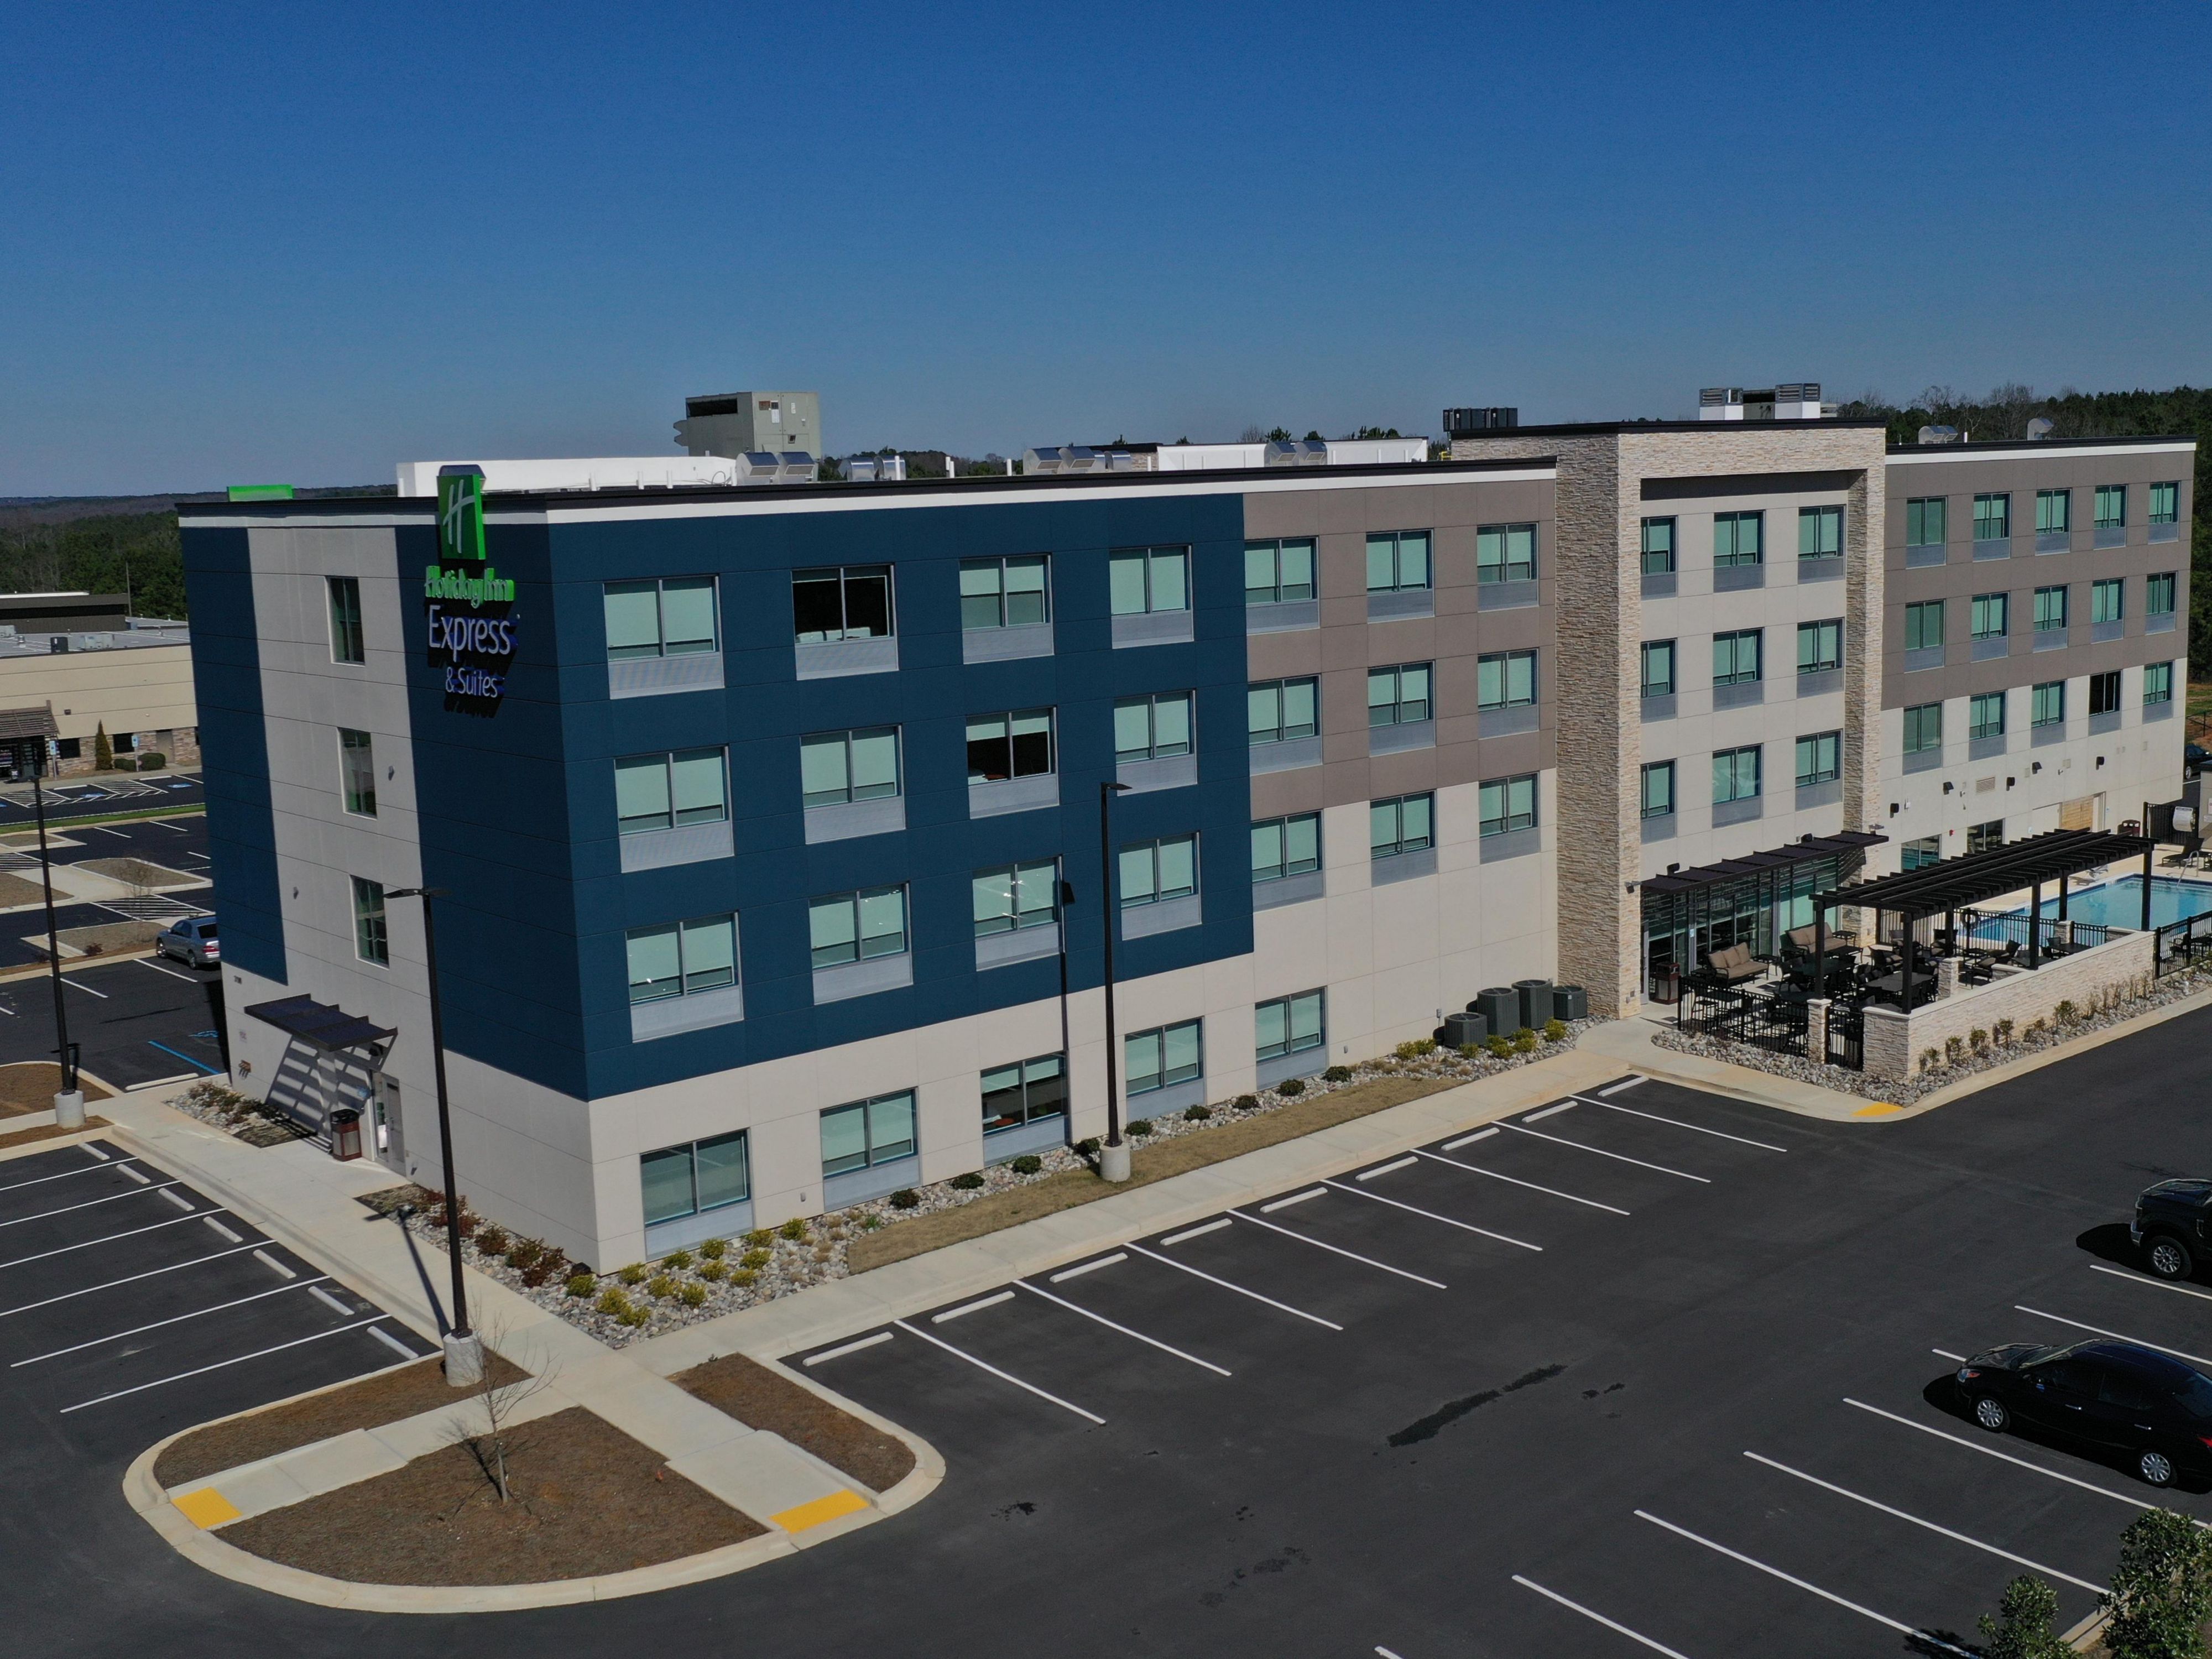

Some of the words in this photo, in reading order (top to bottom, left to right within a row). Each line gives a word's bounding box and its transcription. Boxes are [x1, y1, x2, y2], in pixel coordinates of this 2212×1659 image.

[425, 566, 483, 608] Holiday
[484, 568, 514, 601] Inn
[429, 605, 510, 662] Express
[446, 666, 455, 693] &
[457, 667, 498, 698] Suites
